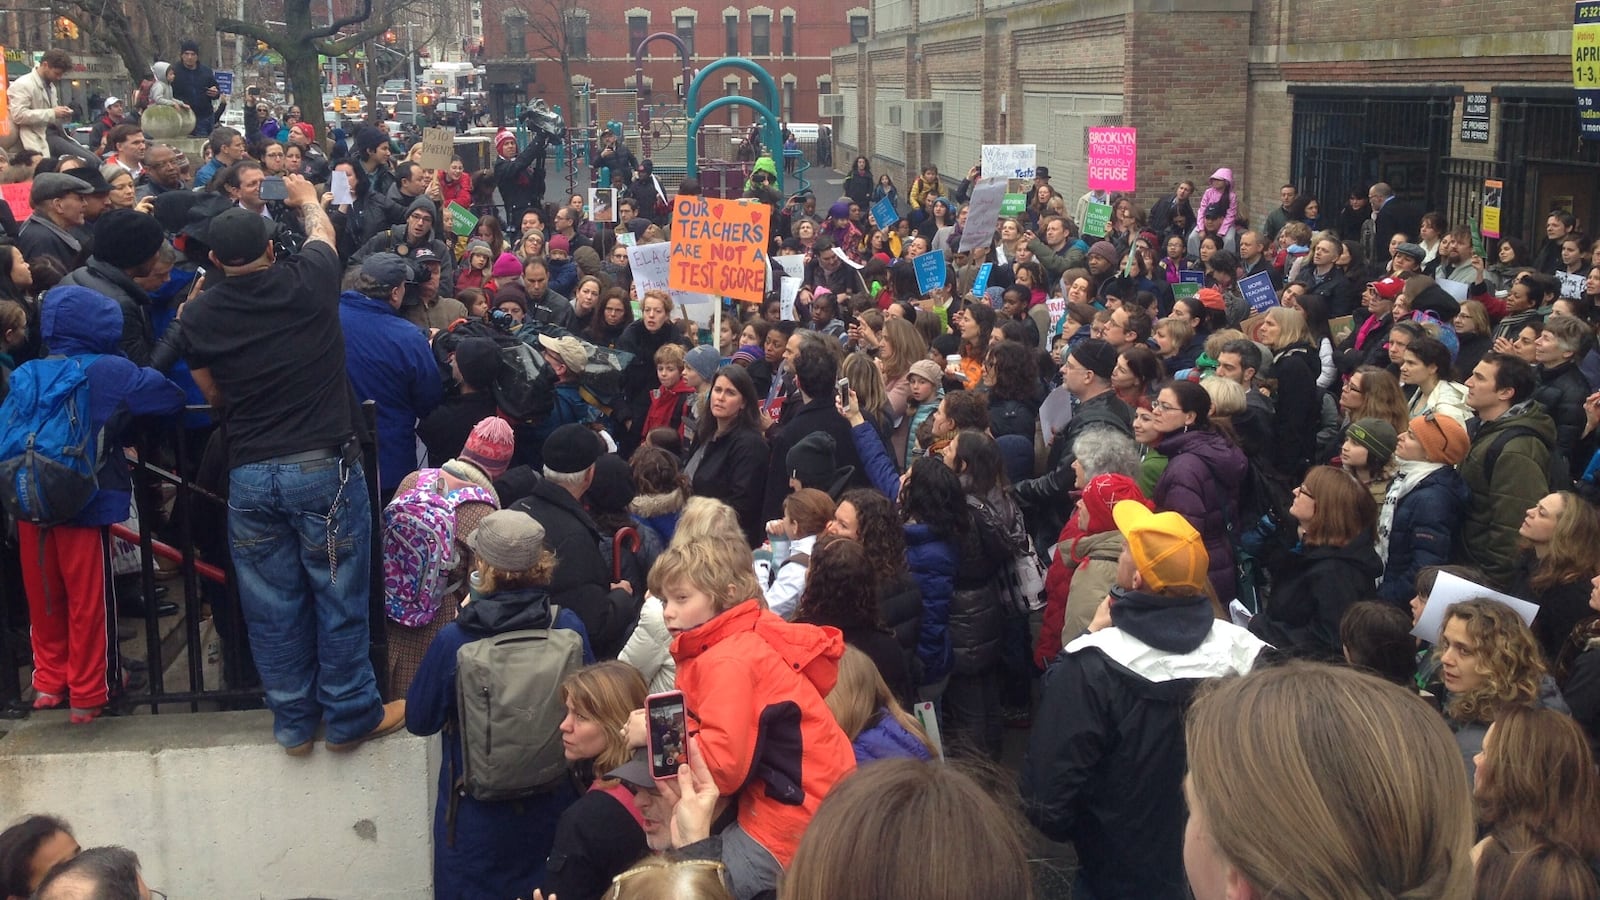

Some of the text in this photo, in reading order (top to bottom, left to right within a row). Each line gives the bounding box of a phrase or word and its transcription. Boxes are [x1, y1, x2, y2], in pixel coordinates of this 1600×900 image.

[1089, 132, 1136, 144] BROOKLYN
[1093, 144, 1134, 156] PARENTS
[1015, 167, 1034, 178] Tests
[1090, 166, 1128, 181] REFUSE
[678, 200, 710, 218] OUR
[678, 219, 764, 245] TEACHERS
[673, 243, 766, 265] ARE NOT A
[678, 261, 765, 293] TEST SCORE
